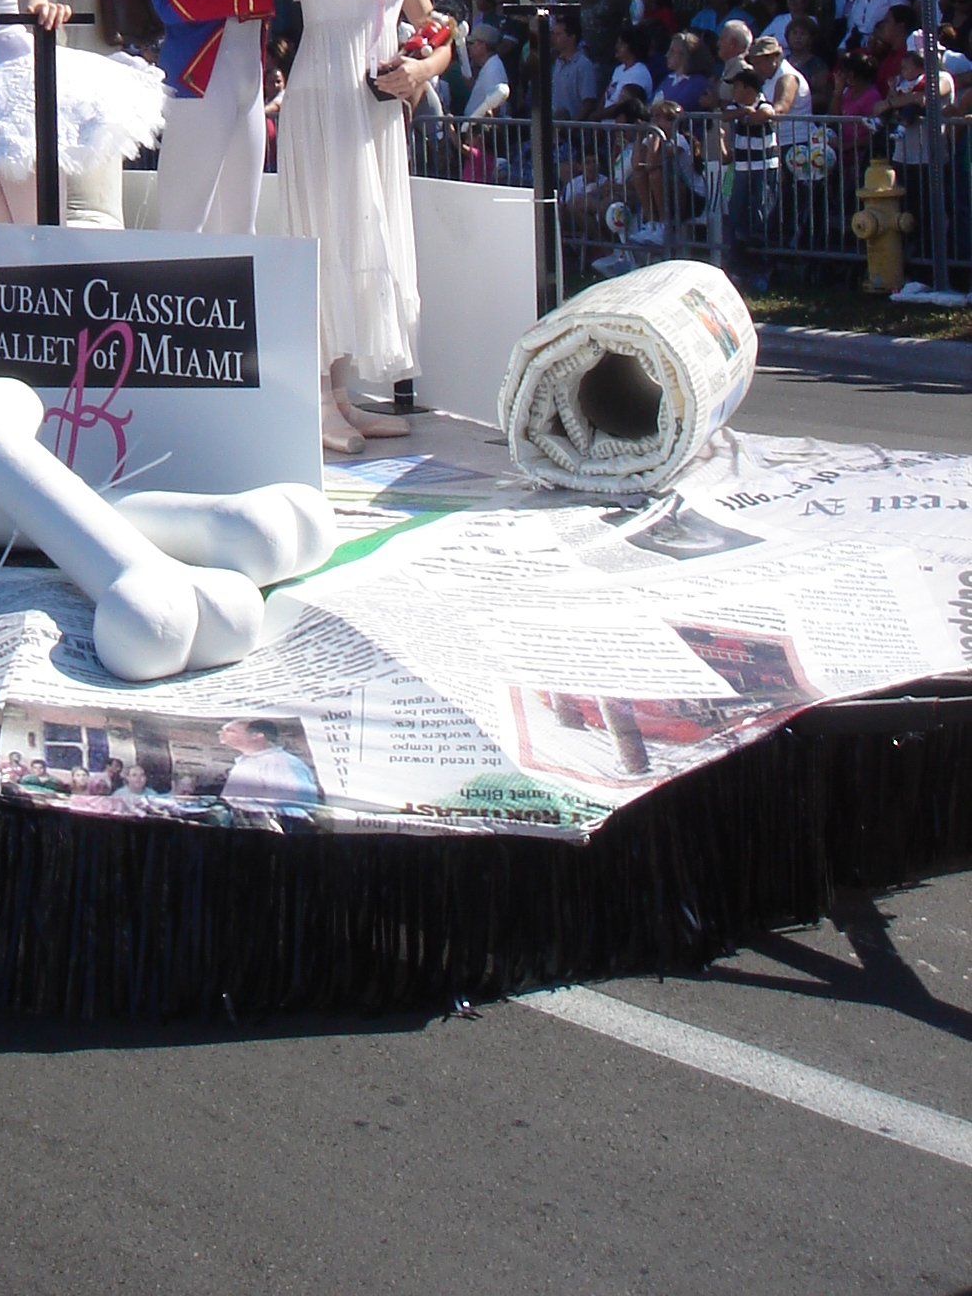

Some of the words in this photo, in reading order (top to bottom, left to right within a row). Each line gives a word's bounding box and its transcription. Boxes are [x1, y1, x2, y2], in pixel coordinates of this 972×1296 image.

[389, 755, 434, 764] toward
[440, 757, 475, 766] trend
[481, 757, 502, 767] the
[460, 788, 503, 801] Birch
